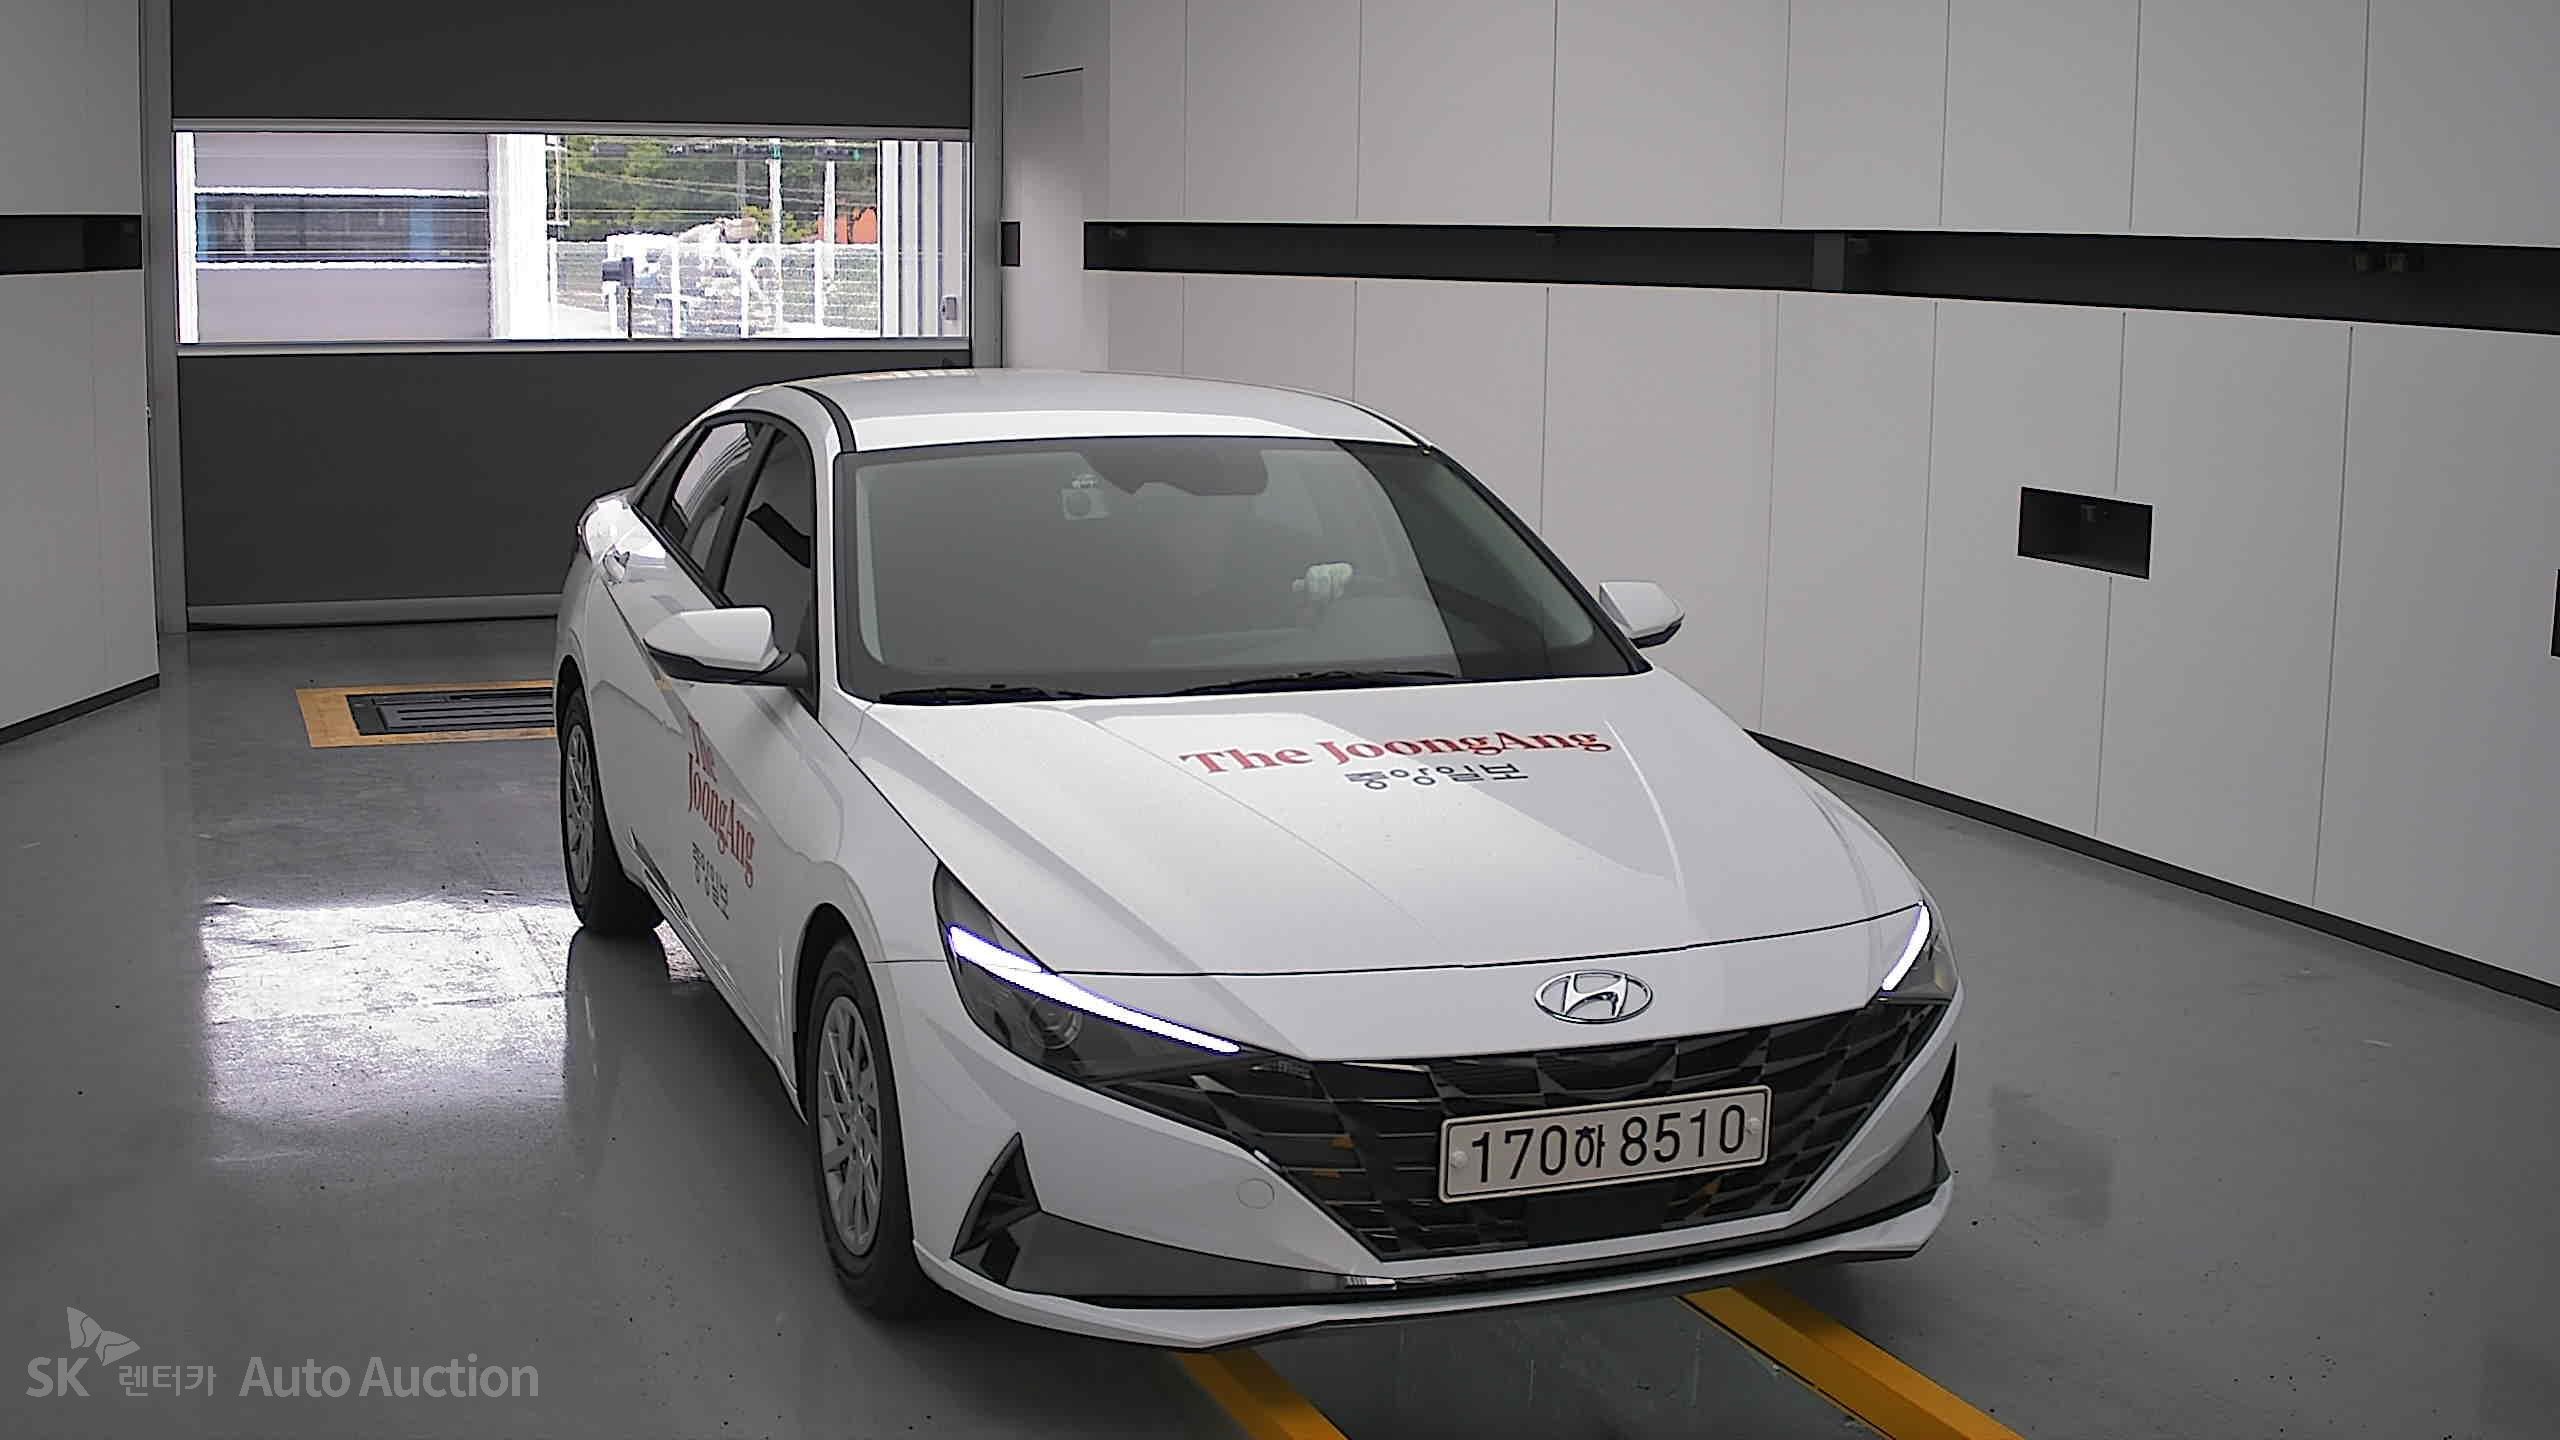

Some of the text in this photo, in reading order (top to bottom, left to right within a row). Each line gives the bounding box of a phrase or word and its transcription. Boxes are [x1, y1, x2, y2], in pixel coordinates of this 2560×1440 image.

[1180, 731, 1611, 774] The JoongAng
[1345, 762, 1528, 790] 중앙일보
[687, 752, 754, 888] JoongAng
[1472, 1104, 1745, 1183] 170하 8510
